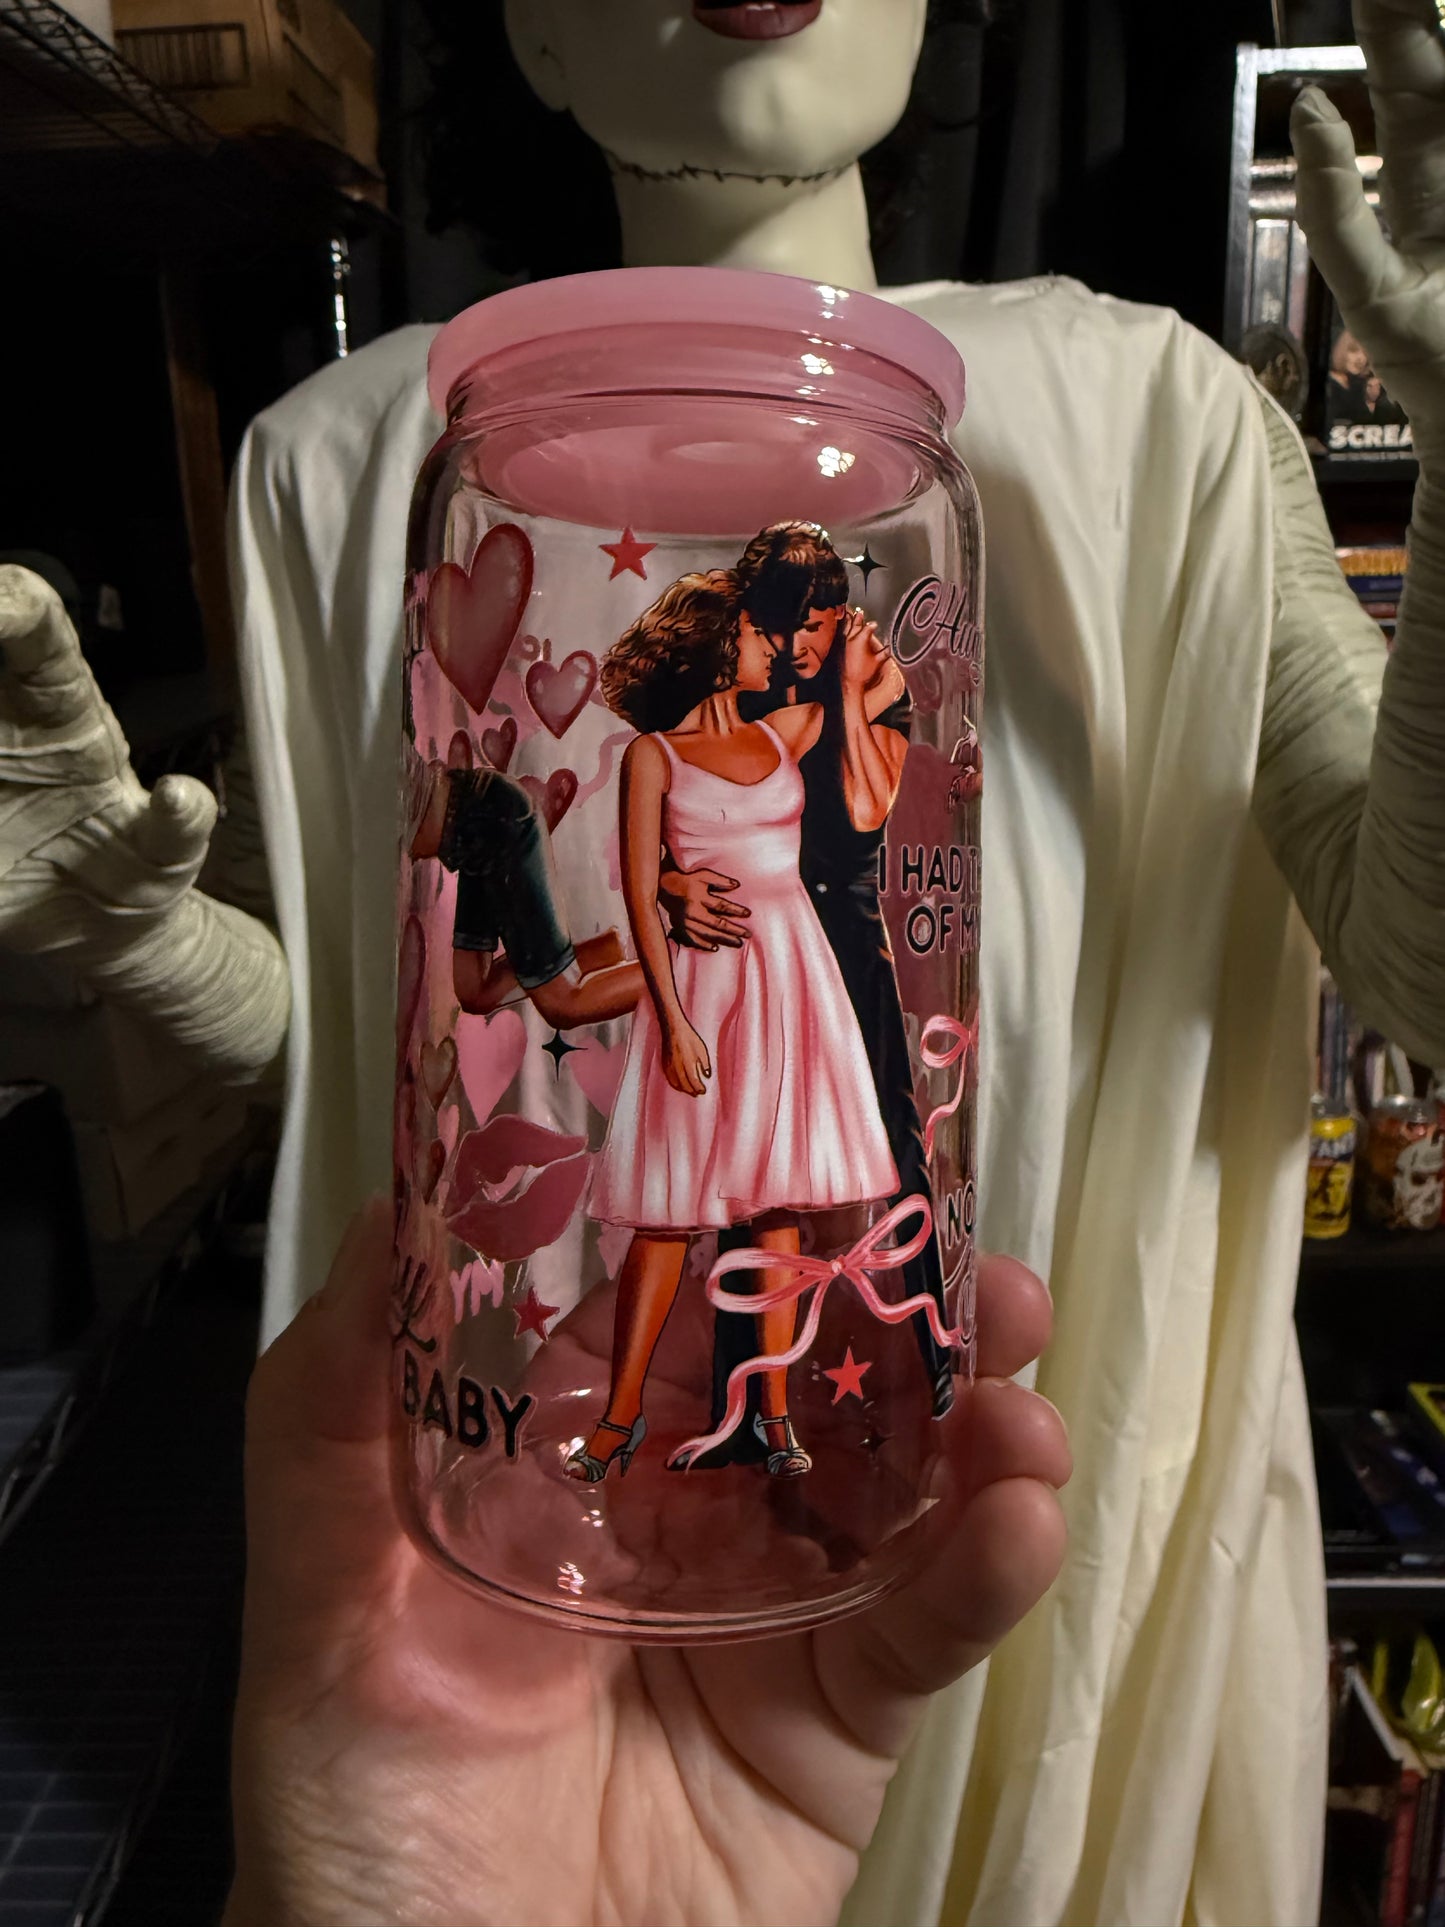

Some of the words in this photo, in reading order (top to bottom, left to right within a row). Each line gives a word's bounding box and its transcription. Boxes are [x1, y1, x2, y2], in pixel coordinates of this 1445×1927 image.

[878, 844, 888, 893] I
[901, 844, 963, 894] HAD
[906, 904, 954, 954] OF
[402, 1349, 535, 1459] BABY
